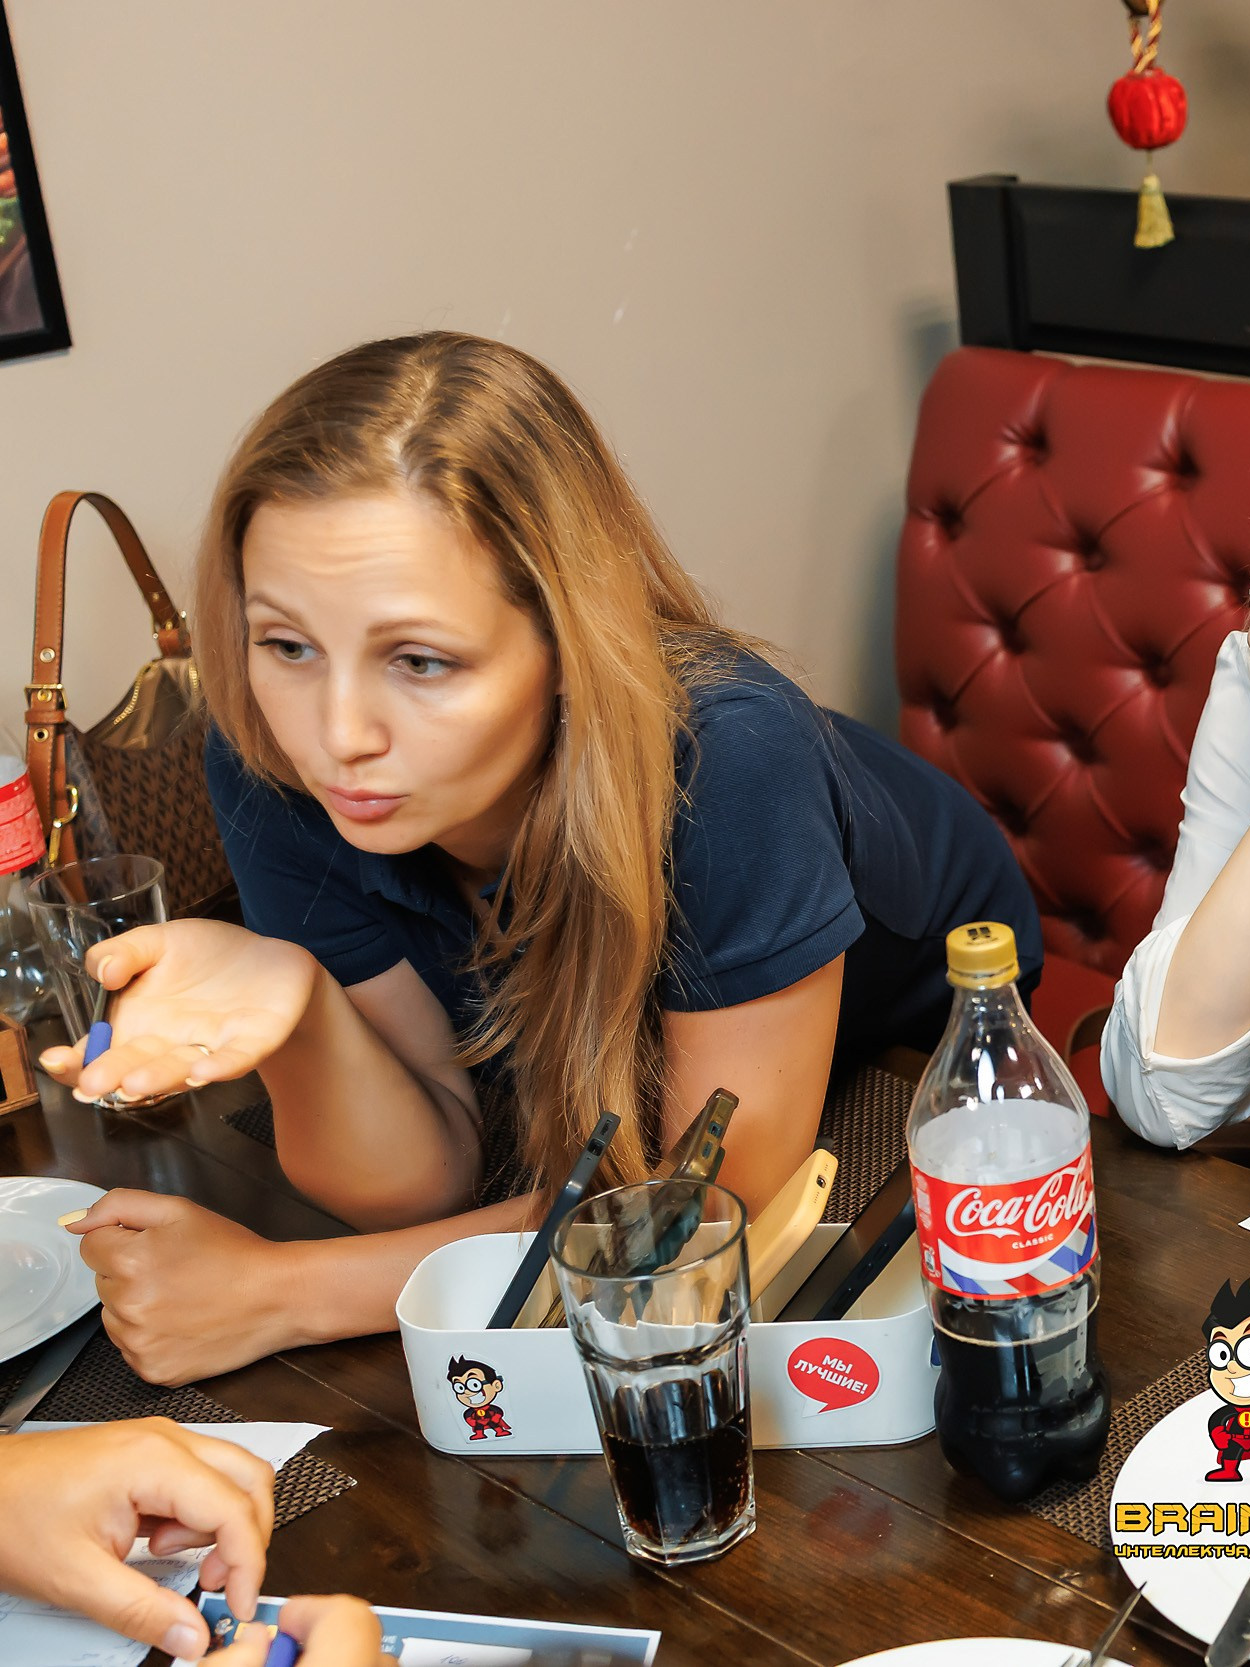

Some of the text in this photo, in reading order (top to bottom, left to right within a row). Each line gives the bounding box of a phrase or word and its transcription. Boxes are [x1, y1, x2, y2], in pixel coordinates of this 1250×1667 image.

[945, 1155, 1087, 1238] Coca-Cola
[1011, 1233, 1054, 1250] CLASSIC
[794, 1359, 869, 1395] ЛУЧШИЕ!
[822, 1354, 853, 1374] МЫ
